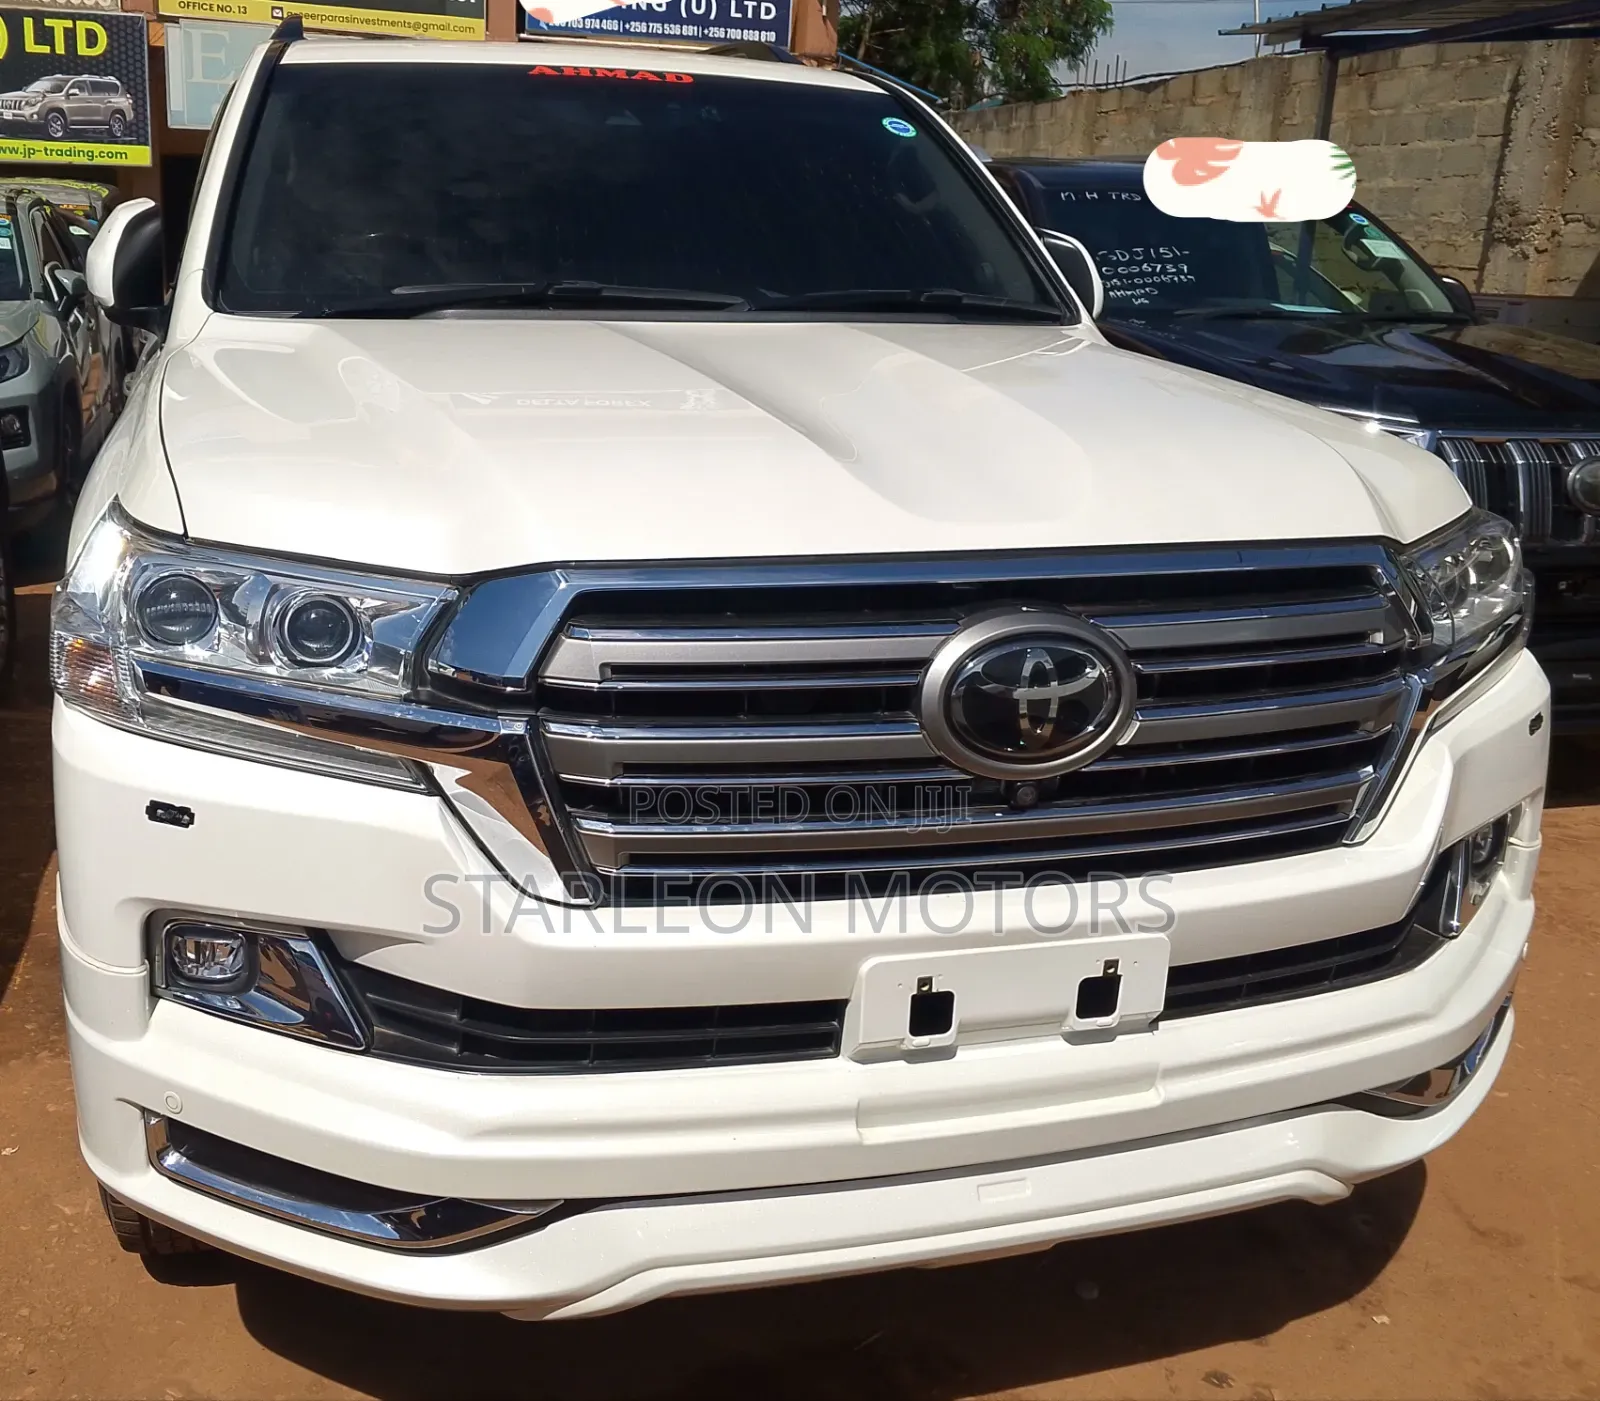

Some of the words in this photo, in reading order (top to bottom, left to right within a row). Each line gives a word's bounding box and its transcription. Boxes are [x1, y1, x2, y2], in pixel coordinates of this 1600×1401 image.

[178, 0, 215, 12] OFFICE
[216, 3, 236, 14] NO.
[237, 5, 248, 15] 13
[680, 0, 717, 20] (U)
[730, 0, 777, 20] LTD
[23, 16, 108, 57] LTD
[584, 18, 600, 29] 974
[601, 19, 619, 31] 466
[624, 21, 647, 32] +256
[648, 22, 662, 34] 775
[663, 23, 681, 35] 536
[703, 26, 725, 38] +256
[726, 28, 742, 39] 700
[528, 65, 694, 83] AHMAD
[1085, 191, 1099, 200] H
